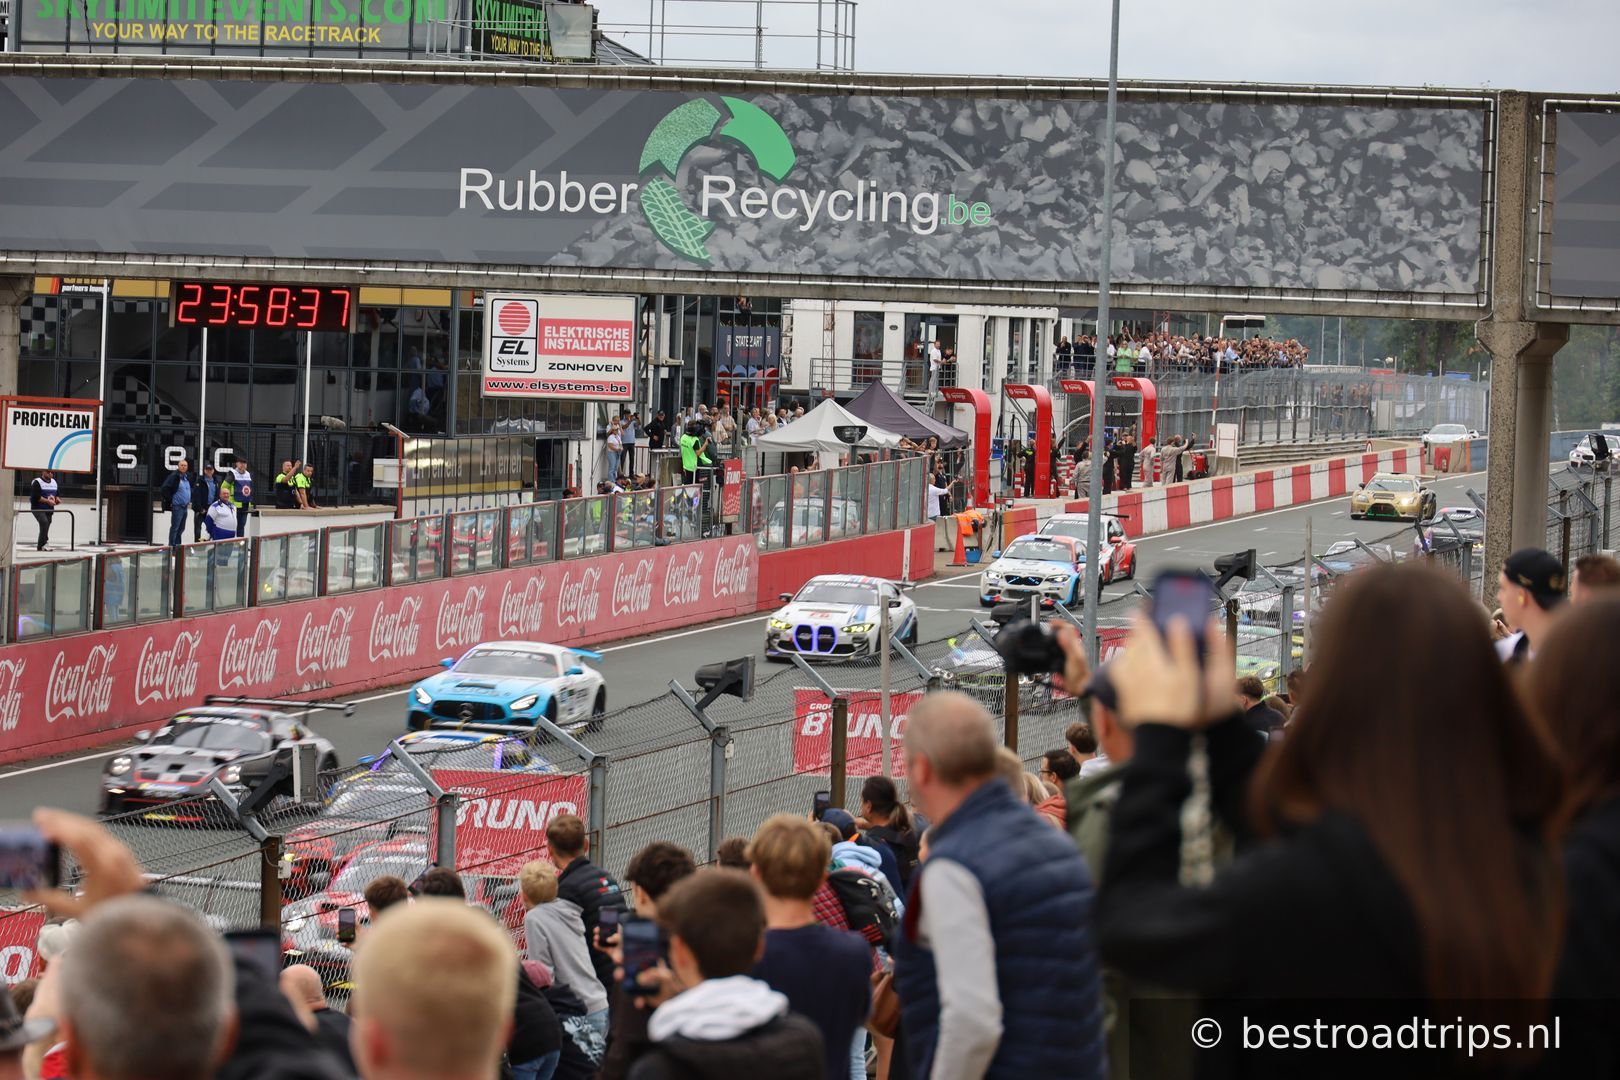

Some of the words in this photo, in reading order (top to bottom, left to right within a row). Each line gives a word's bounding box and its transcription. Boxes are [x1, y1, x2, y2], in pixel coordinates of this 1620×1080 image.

[92, 22, 144, 39] YOUR
[149, 23, 189, 40] WAY
[193, 24, 218, 40] TO
[223, 25, 259, 41] THE
[264, 25, 381, 43] RACETRACK
[491, 34, 508, 53] YOUR
[508, 38, 521, 55] WAY
[459, 167, 639, 213] Rubber
[702, 175, 991, 235] Recycling.be
[178, 285, 350, 327] 23:58:37
[544, 326, 630, 340] ELEKTRISCHE
[498, 340, 529, 355] EL
[544, 338, 630, 352] INSTALLATIES
[497, 356, 530, 367] Systems
[548, 363, 623, 372] ZONHOVEN
[488, 381, 627, 392] www.elsystems.be
[13, 411, 90, 429] PROFICLEAN
[801, 712, 908, 740] BUNO
[449, 787, 486, 795] GROUP
